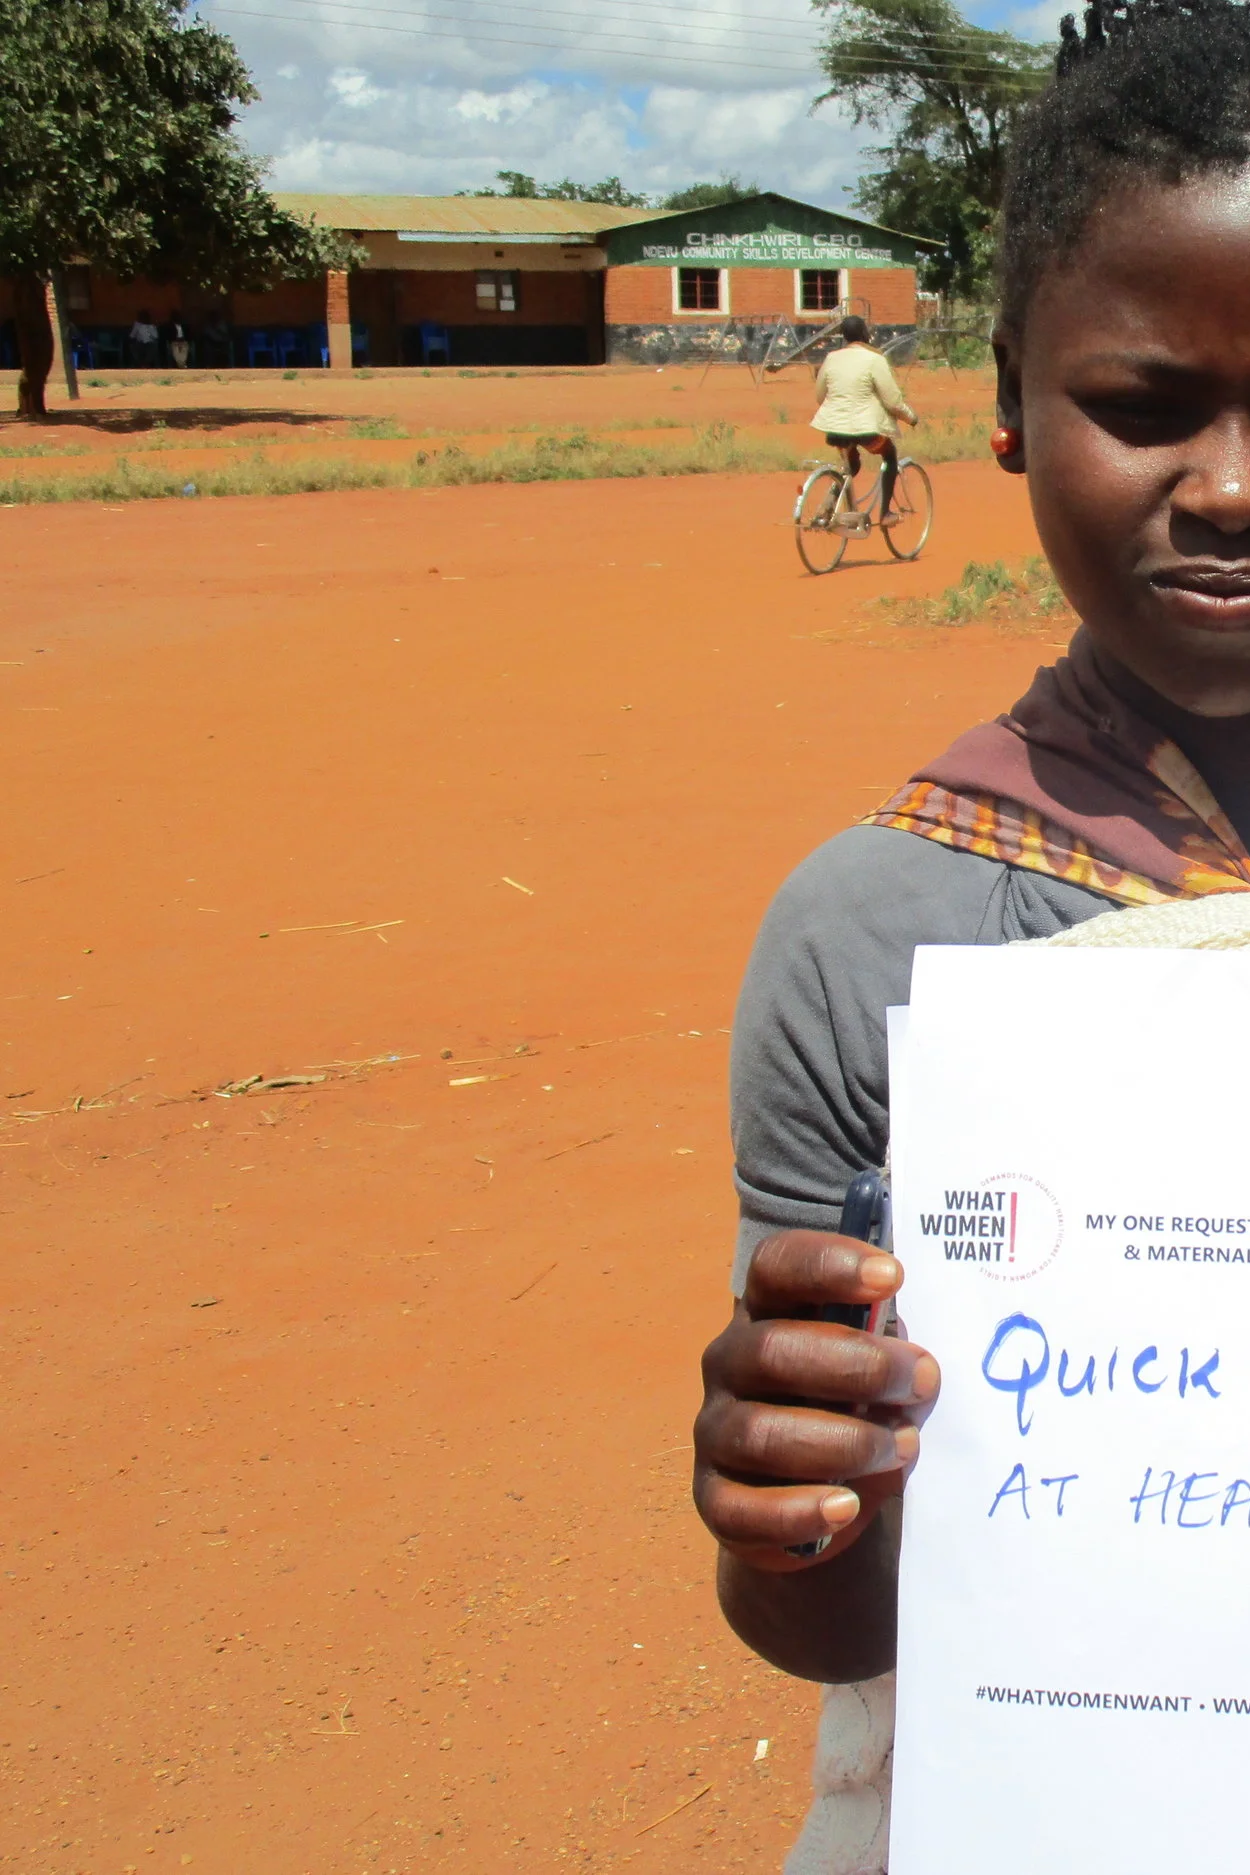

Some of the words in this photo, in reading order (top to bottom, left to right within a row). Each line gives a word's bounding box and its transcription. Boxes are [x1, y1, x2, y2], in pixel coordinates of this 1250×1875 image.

[686, 232, 801, 247] CHINKHWIRI
[681, 246, 738, 259] COMMUNITY
[742, 247, 778, 260] SKILLS
[781, 247, 852, 260] DEVELOPMENT
[854, 248, 892, 261] CENTRE
[980, 1171, 1016, 1187] DEMANDS
[1018, 1173, 1034, 1183] FOR
[944, 1190, 1006, 1212] WHAT
[920, 1213, 1005, 1238] WOMEN
[1085, 1214, 1117, 1230] MY
[1123, 1215, 1165, 1232] ONE
[944, 1240, 1004, 1262] WANT
[1123, 1244, 1141, 1261] &
[981, 1311, 1221, 1436] QUICK
[988, 1462, 1079, 1519] AT
[975, 1685, 1192, 1713] #WHATWOMENWANT
